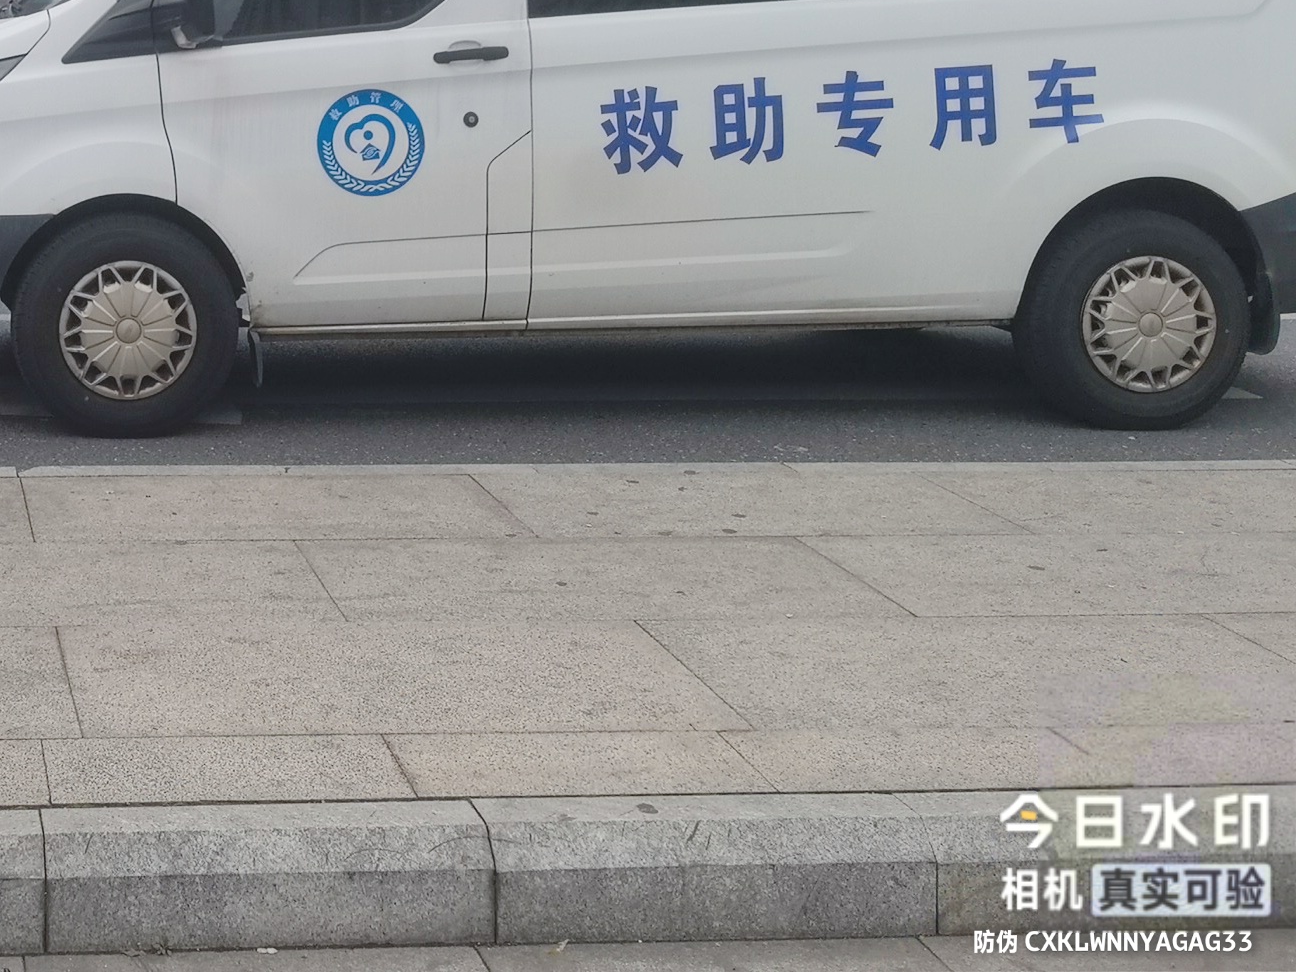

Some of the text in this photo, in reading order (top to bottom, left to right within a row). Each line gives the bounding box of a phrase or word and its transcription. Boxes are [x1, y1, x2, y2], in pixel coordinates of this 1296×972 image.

[599, 58, 1105, 175] 救助专用车
